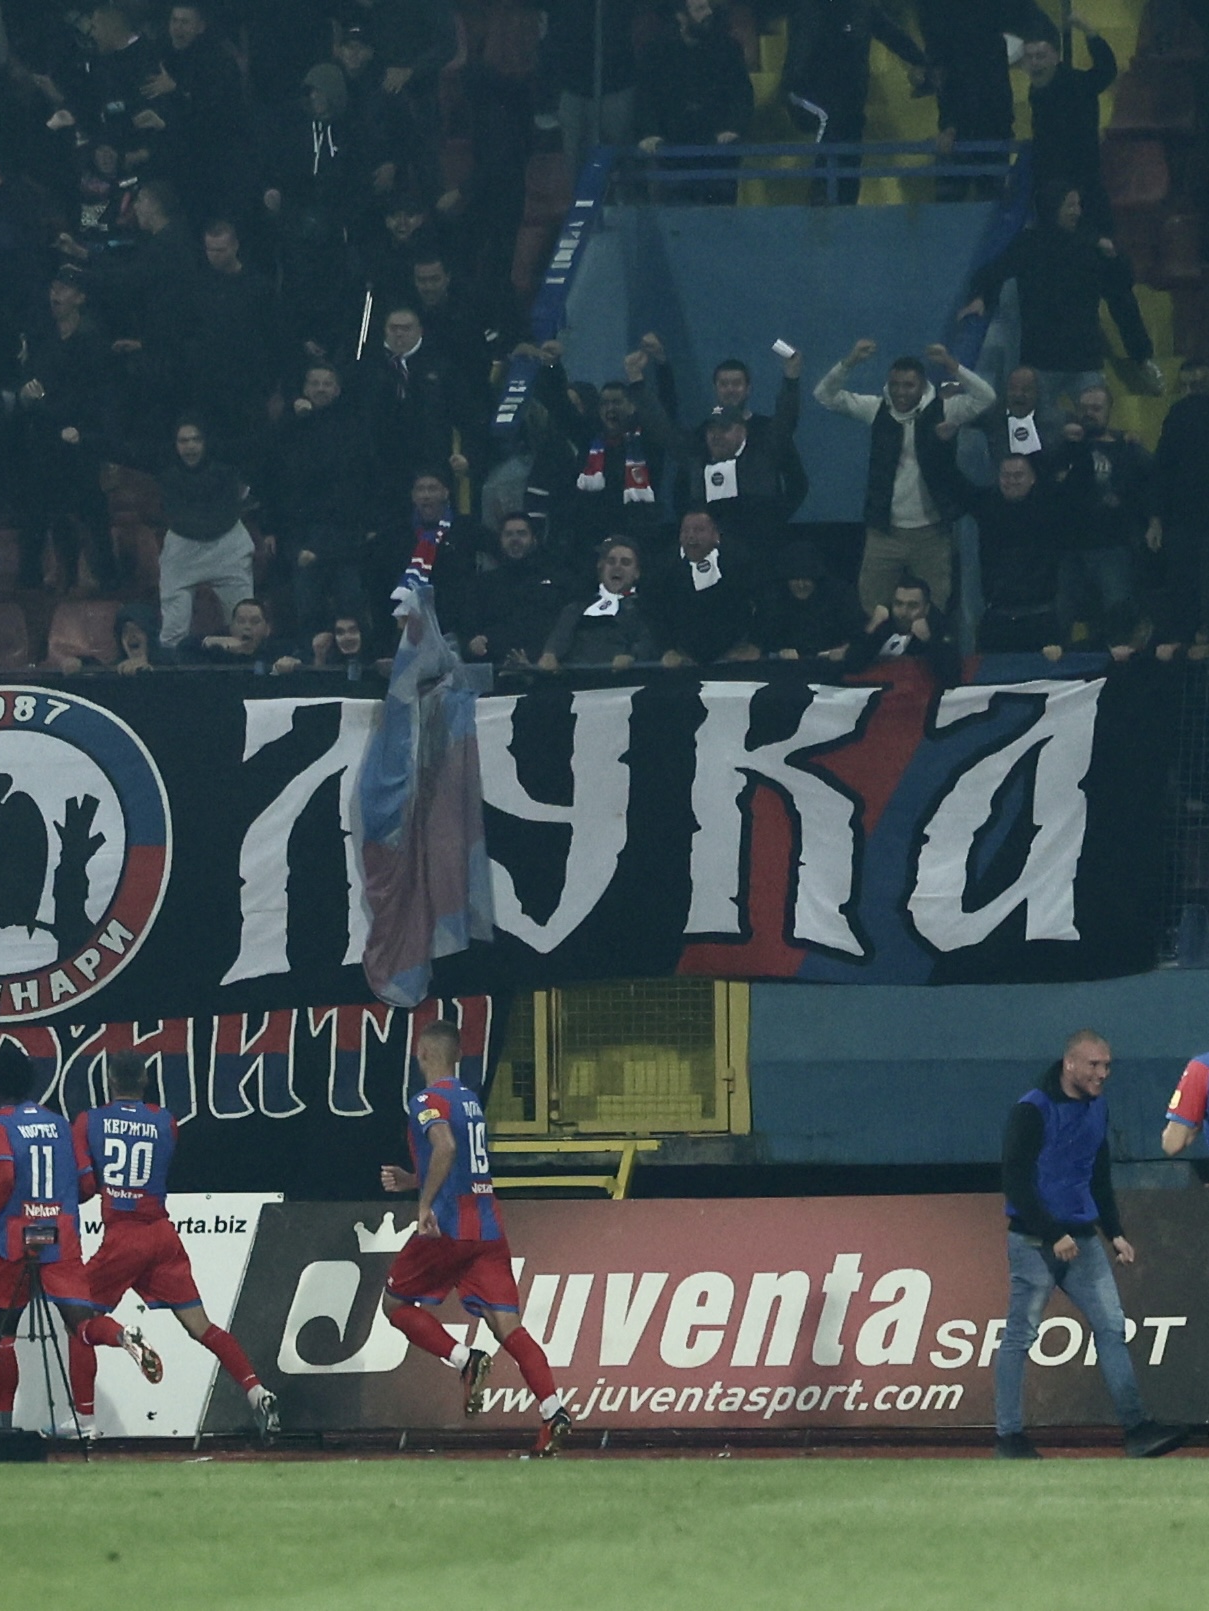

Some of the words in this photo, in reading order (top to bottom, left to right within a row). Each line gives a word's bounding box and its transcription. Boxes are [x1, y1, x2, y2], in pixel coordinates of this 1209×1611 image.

[29, 1145, 53, 1199] 11
[103, 1138, 154, 1187] 20
[467, 1121, 489, 1174] 19
[23, 1203, 61, 1218] Nektar
